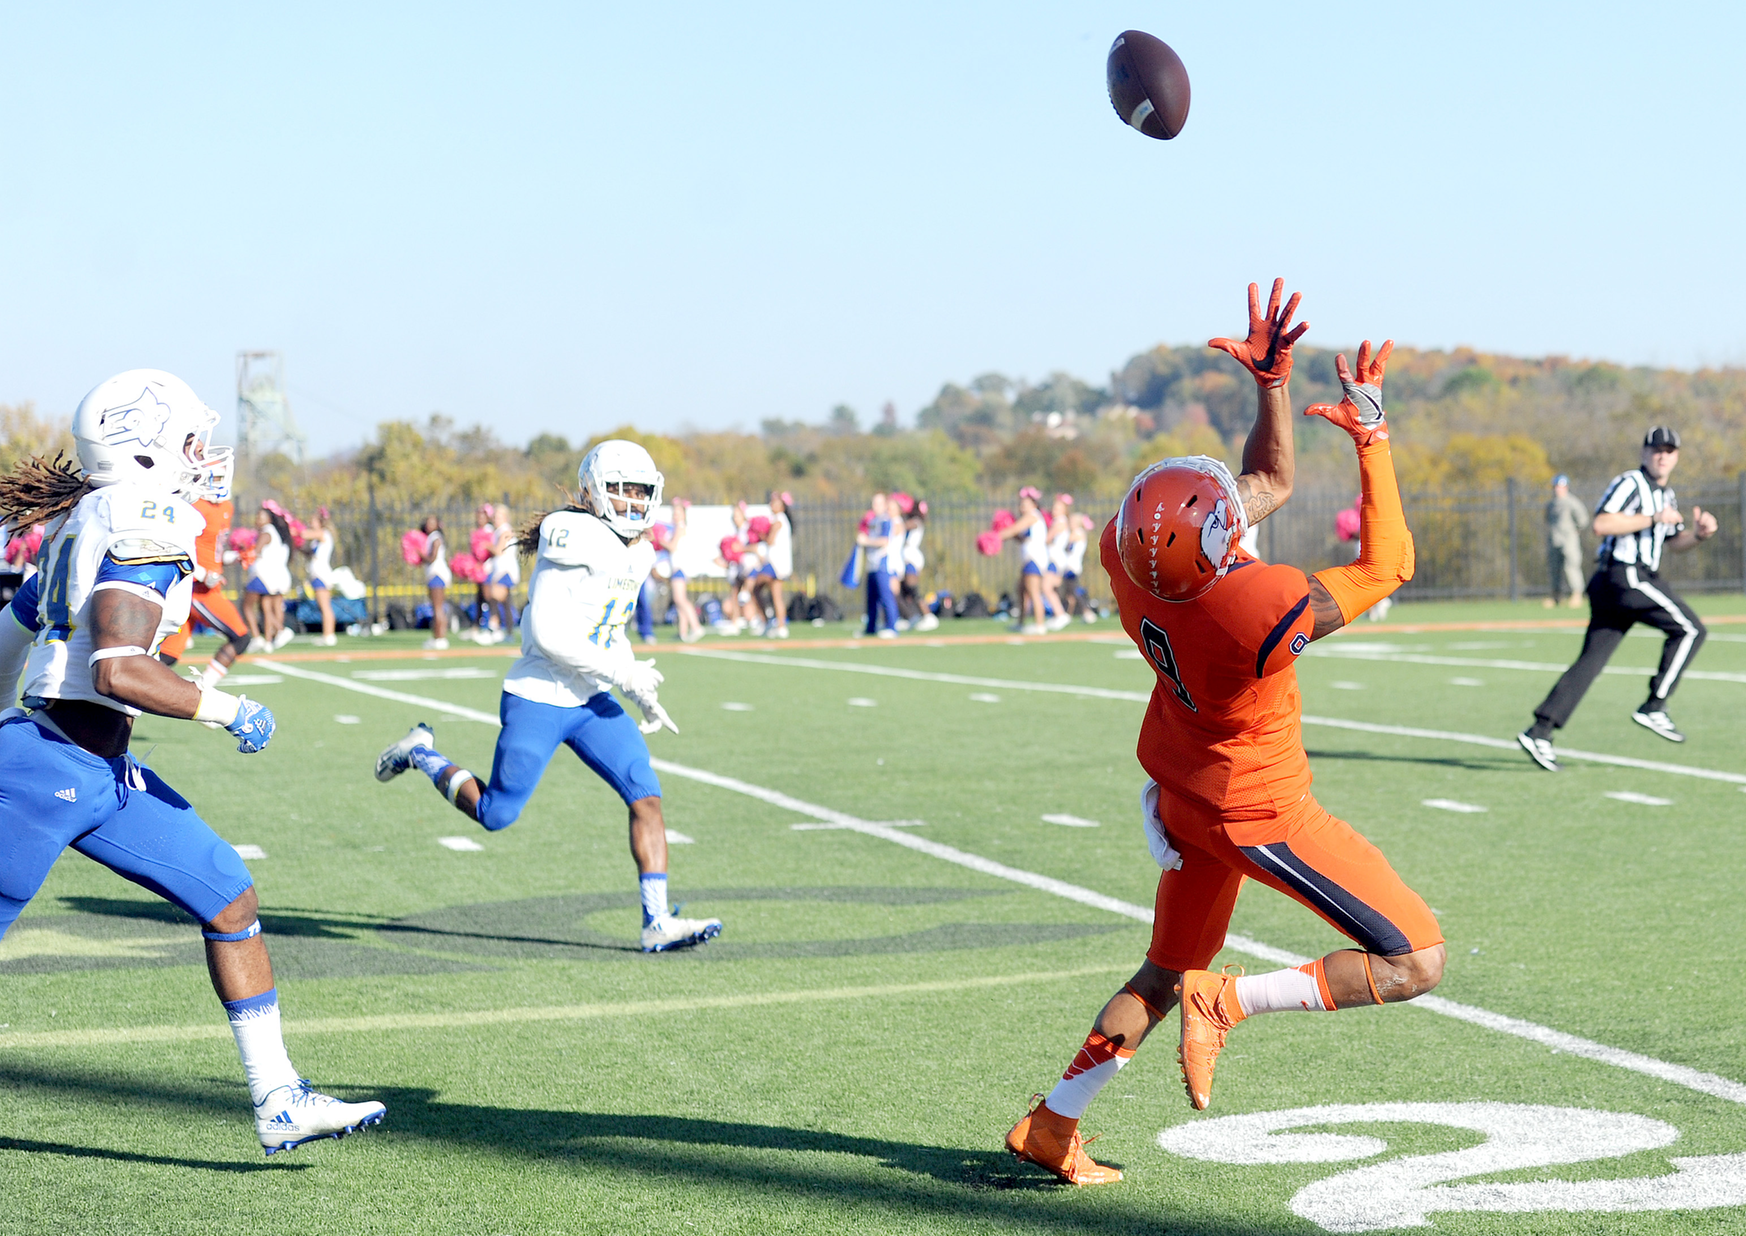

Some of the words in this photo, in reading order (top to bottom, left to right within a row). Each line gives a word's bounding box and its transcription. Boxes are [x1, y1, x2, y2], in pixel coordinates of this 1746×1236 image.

[140, 500, 175, 524] 24
[548, 527, 570, 548] 12
[1139, 615, 1198, 713] 9
[266, 1122, 300, 1132] adidas
